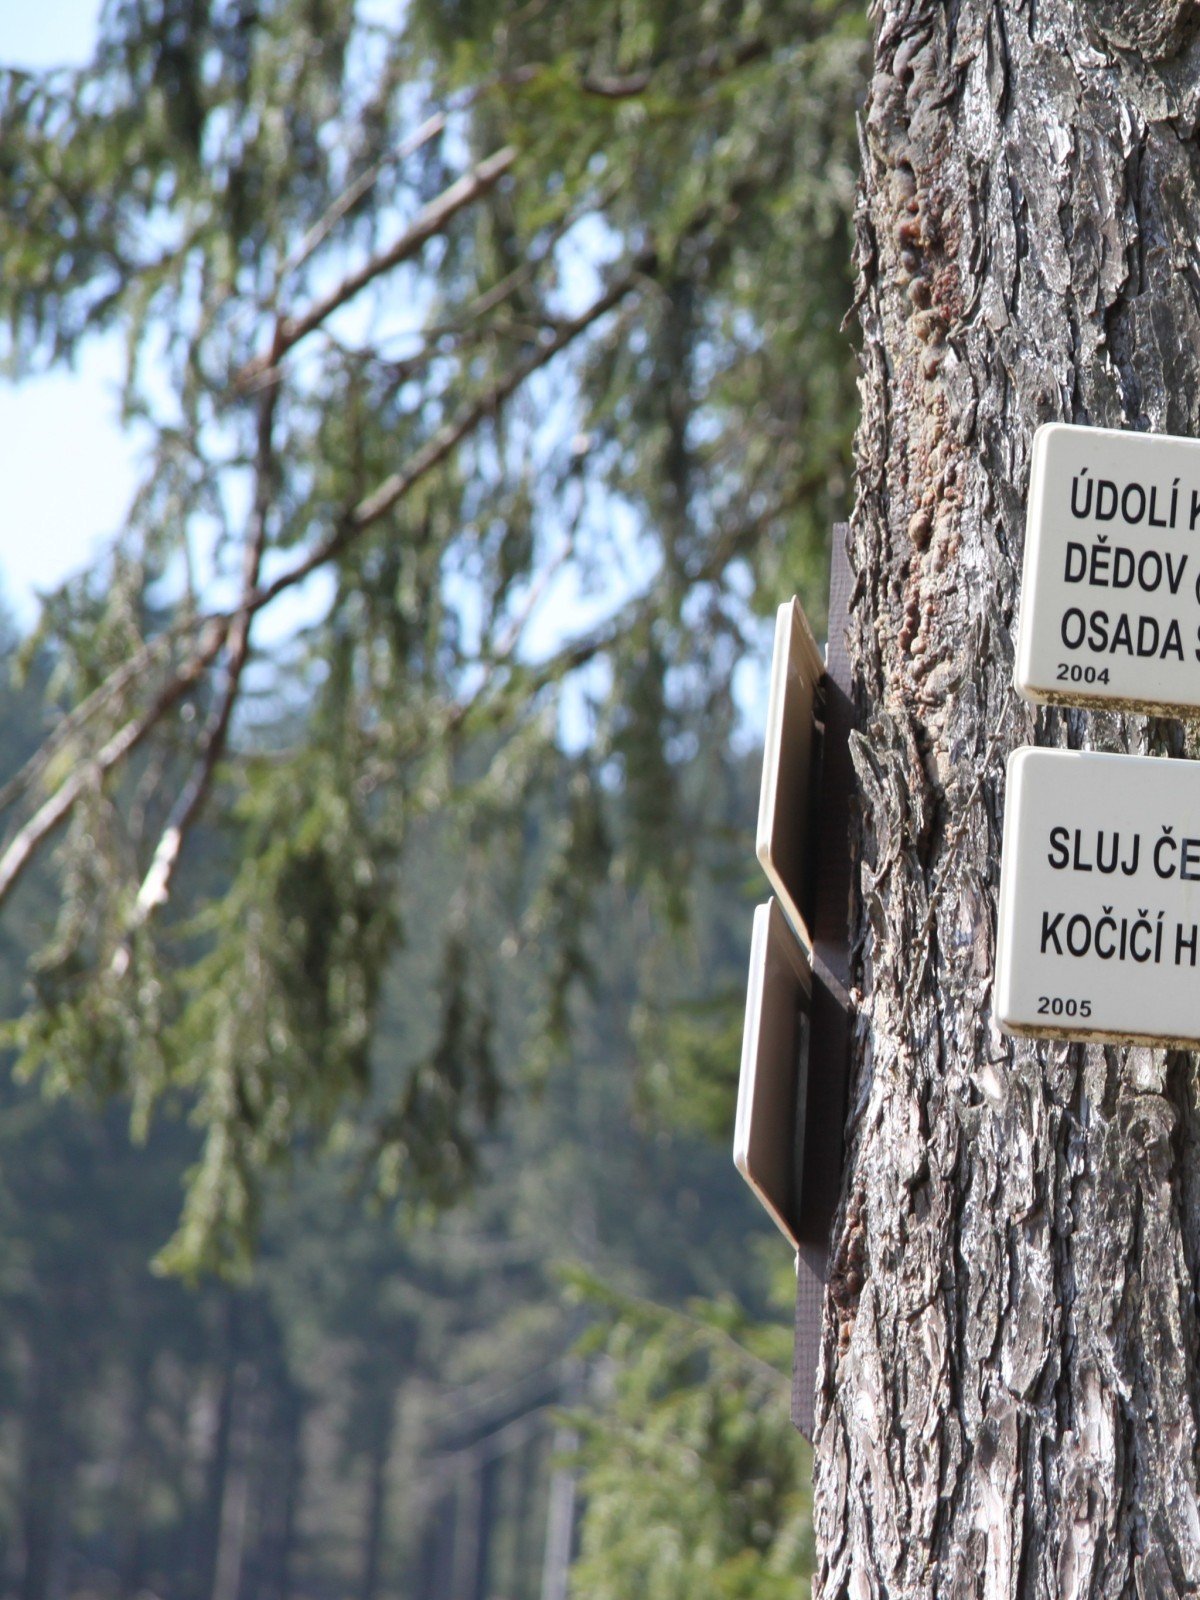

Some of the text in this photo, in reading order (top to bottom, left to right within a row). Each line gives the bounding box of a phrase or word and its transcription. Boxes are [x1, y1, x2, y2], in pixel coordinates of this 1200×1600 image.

[1070, 467, 1181, 529] ÚDOLÍ
[1063, 534, 1189, 595] DĚDOV
[1060, 607, 1185, 662] OSADA
[1056, 663, 1111, 686] 2004
[1047, 826, 1141, 877] SLUJ
[1040, 905, 1165, 964] KOČIČÍ
[1037, 996, 1092, 1018] 2005
